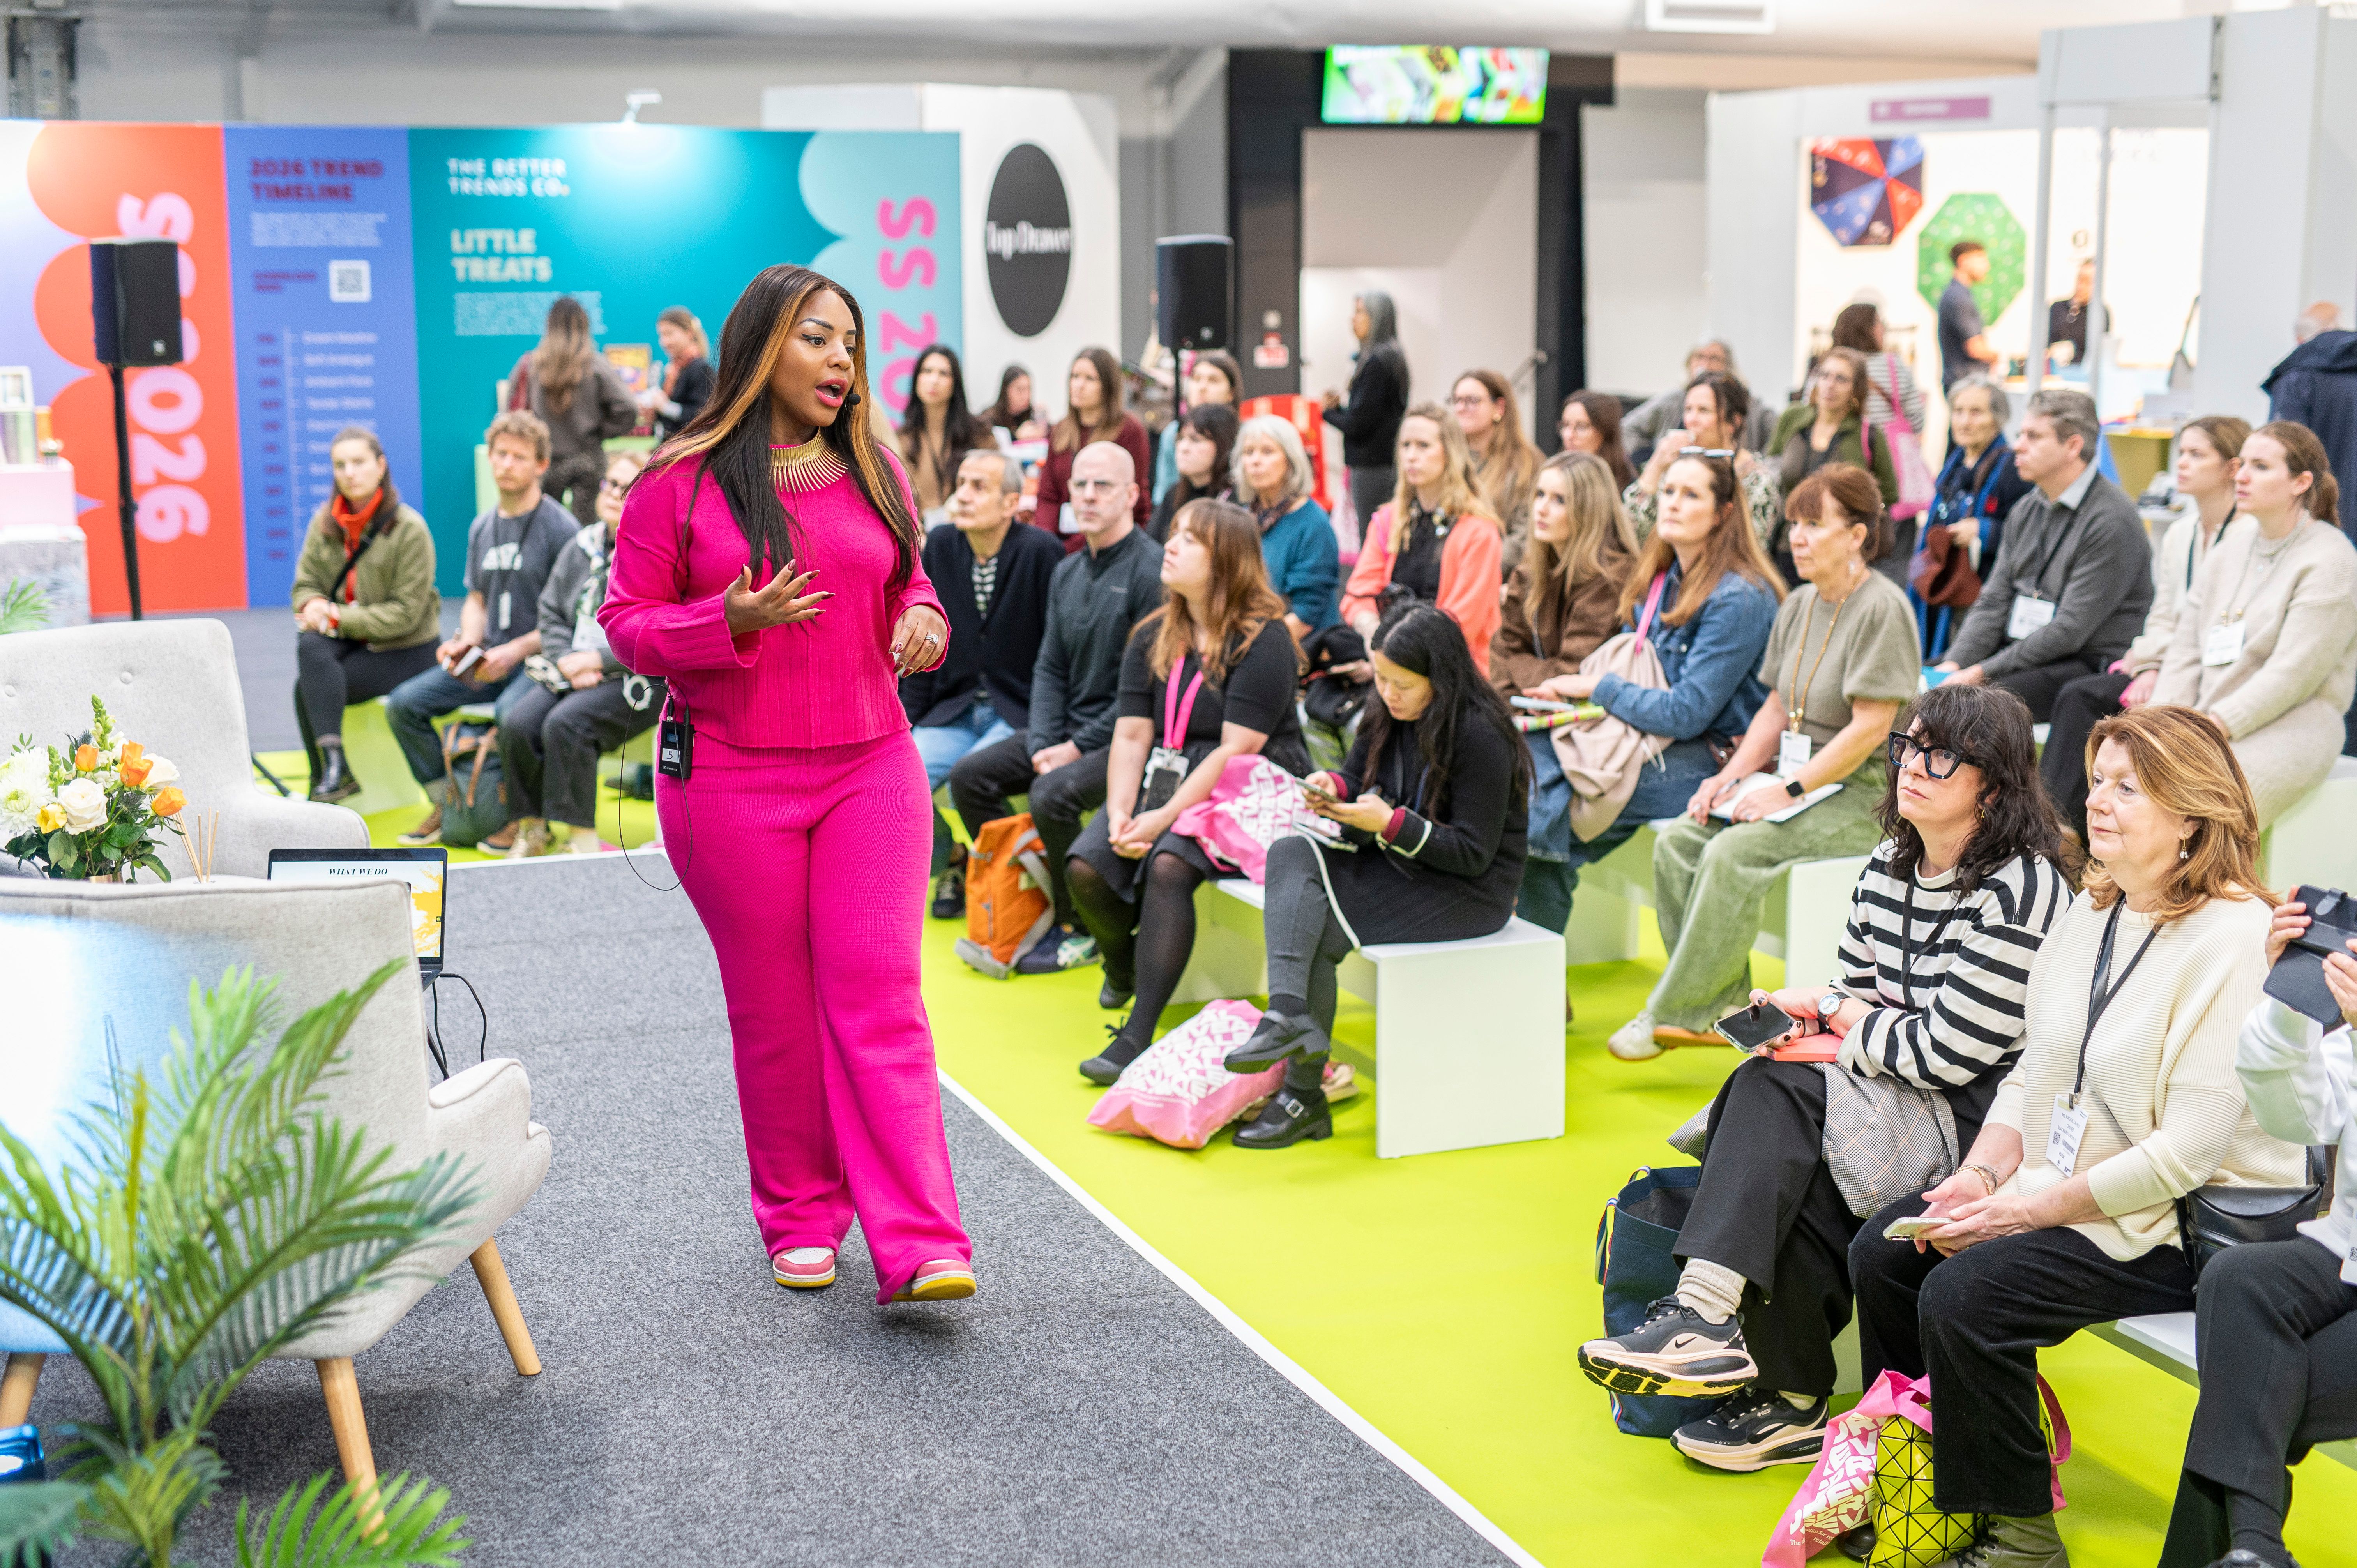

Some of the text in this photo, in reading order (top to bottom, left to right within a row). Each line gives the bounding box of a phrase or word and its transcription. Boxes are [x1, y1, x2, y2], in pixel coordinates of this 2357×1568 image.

[252, 158, 383, 178] 2026 TREND
[448, 158, 566, 178] THE BETTER
[252, 182, 354, 201] TIMELINE
[449, 178, 527, 196] TRENDS
[450, 228, 536, 254] LITTLE
[878, 196, 937, 291] SS
[451, 256, 552, 283] TREATS
[666, 751, 673, 759] 5
